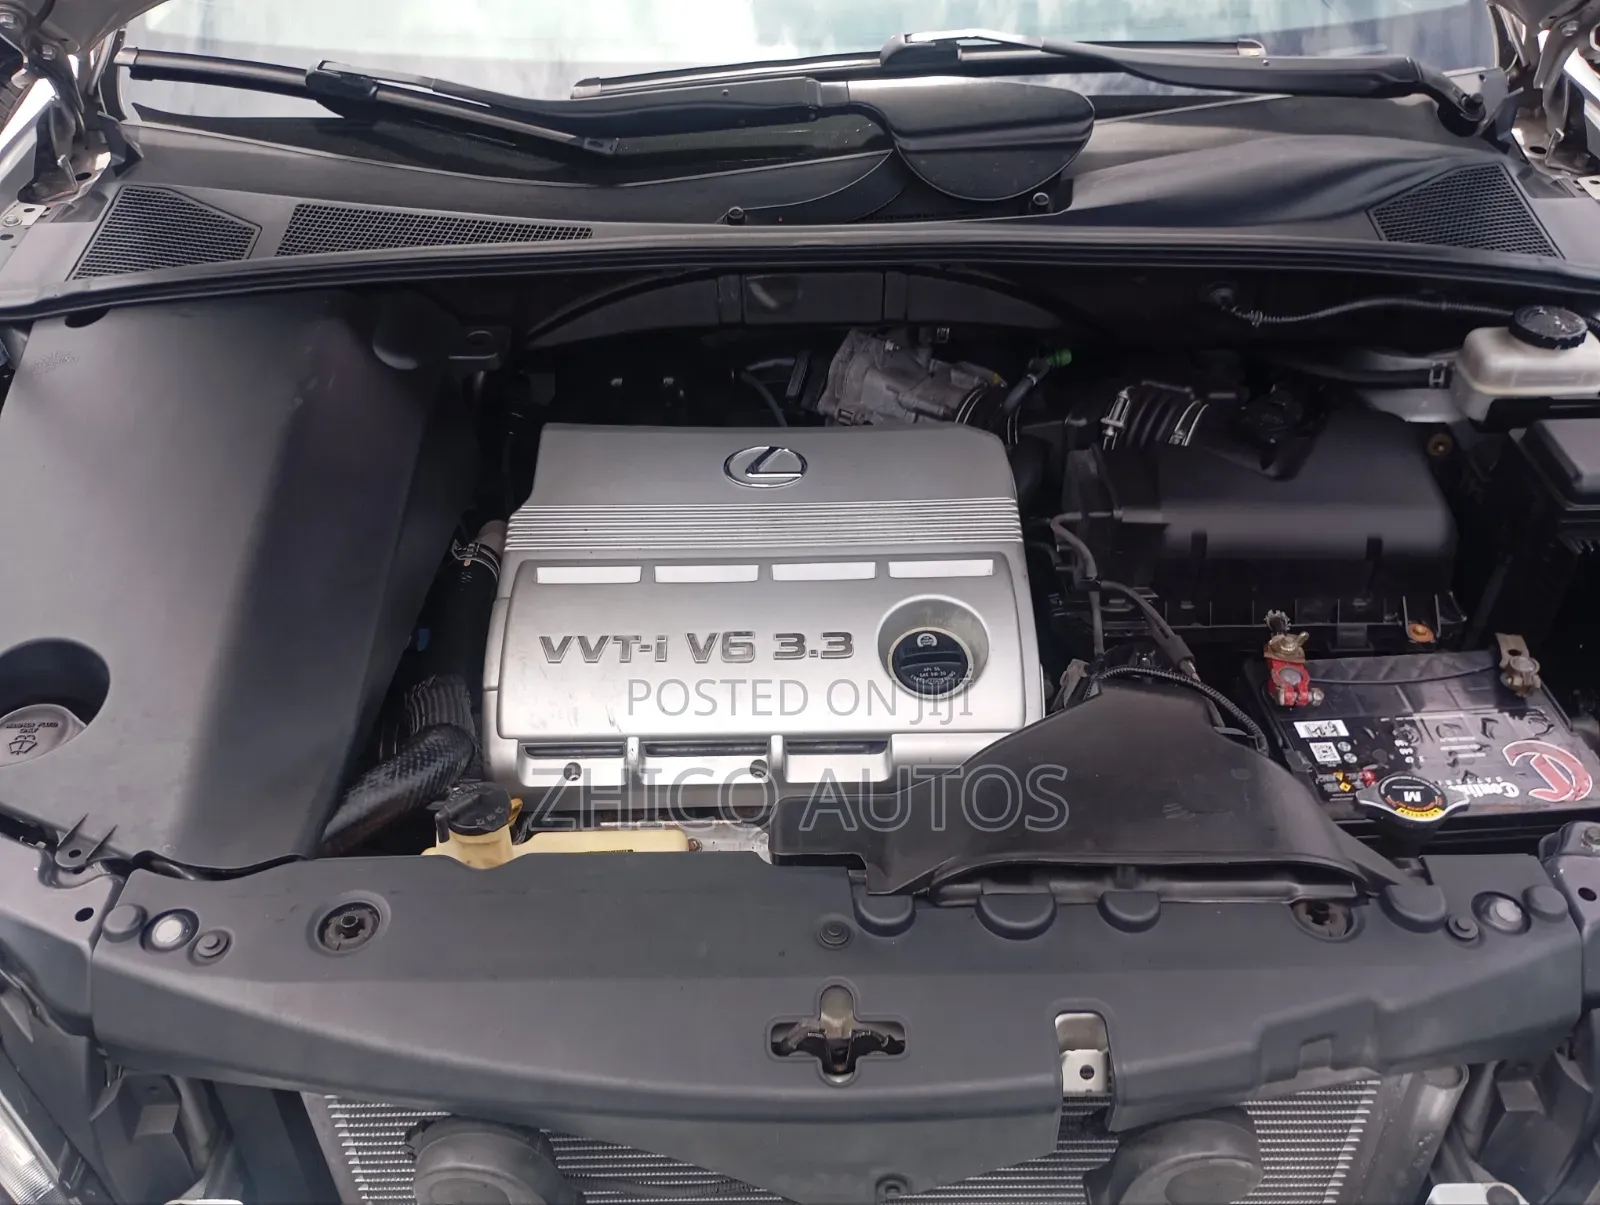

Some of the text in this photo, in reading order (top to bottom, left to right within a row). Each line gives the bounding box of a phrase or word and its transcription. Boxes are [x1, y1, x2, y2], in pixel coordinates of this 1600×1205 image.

[538, 631, 855, 664] VVT-i V6 3.3
